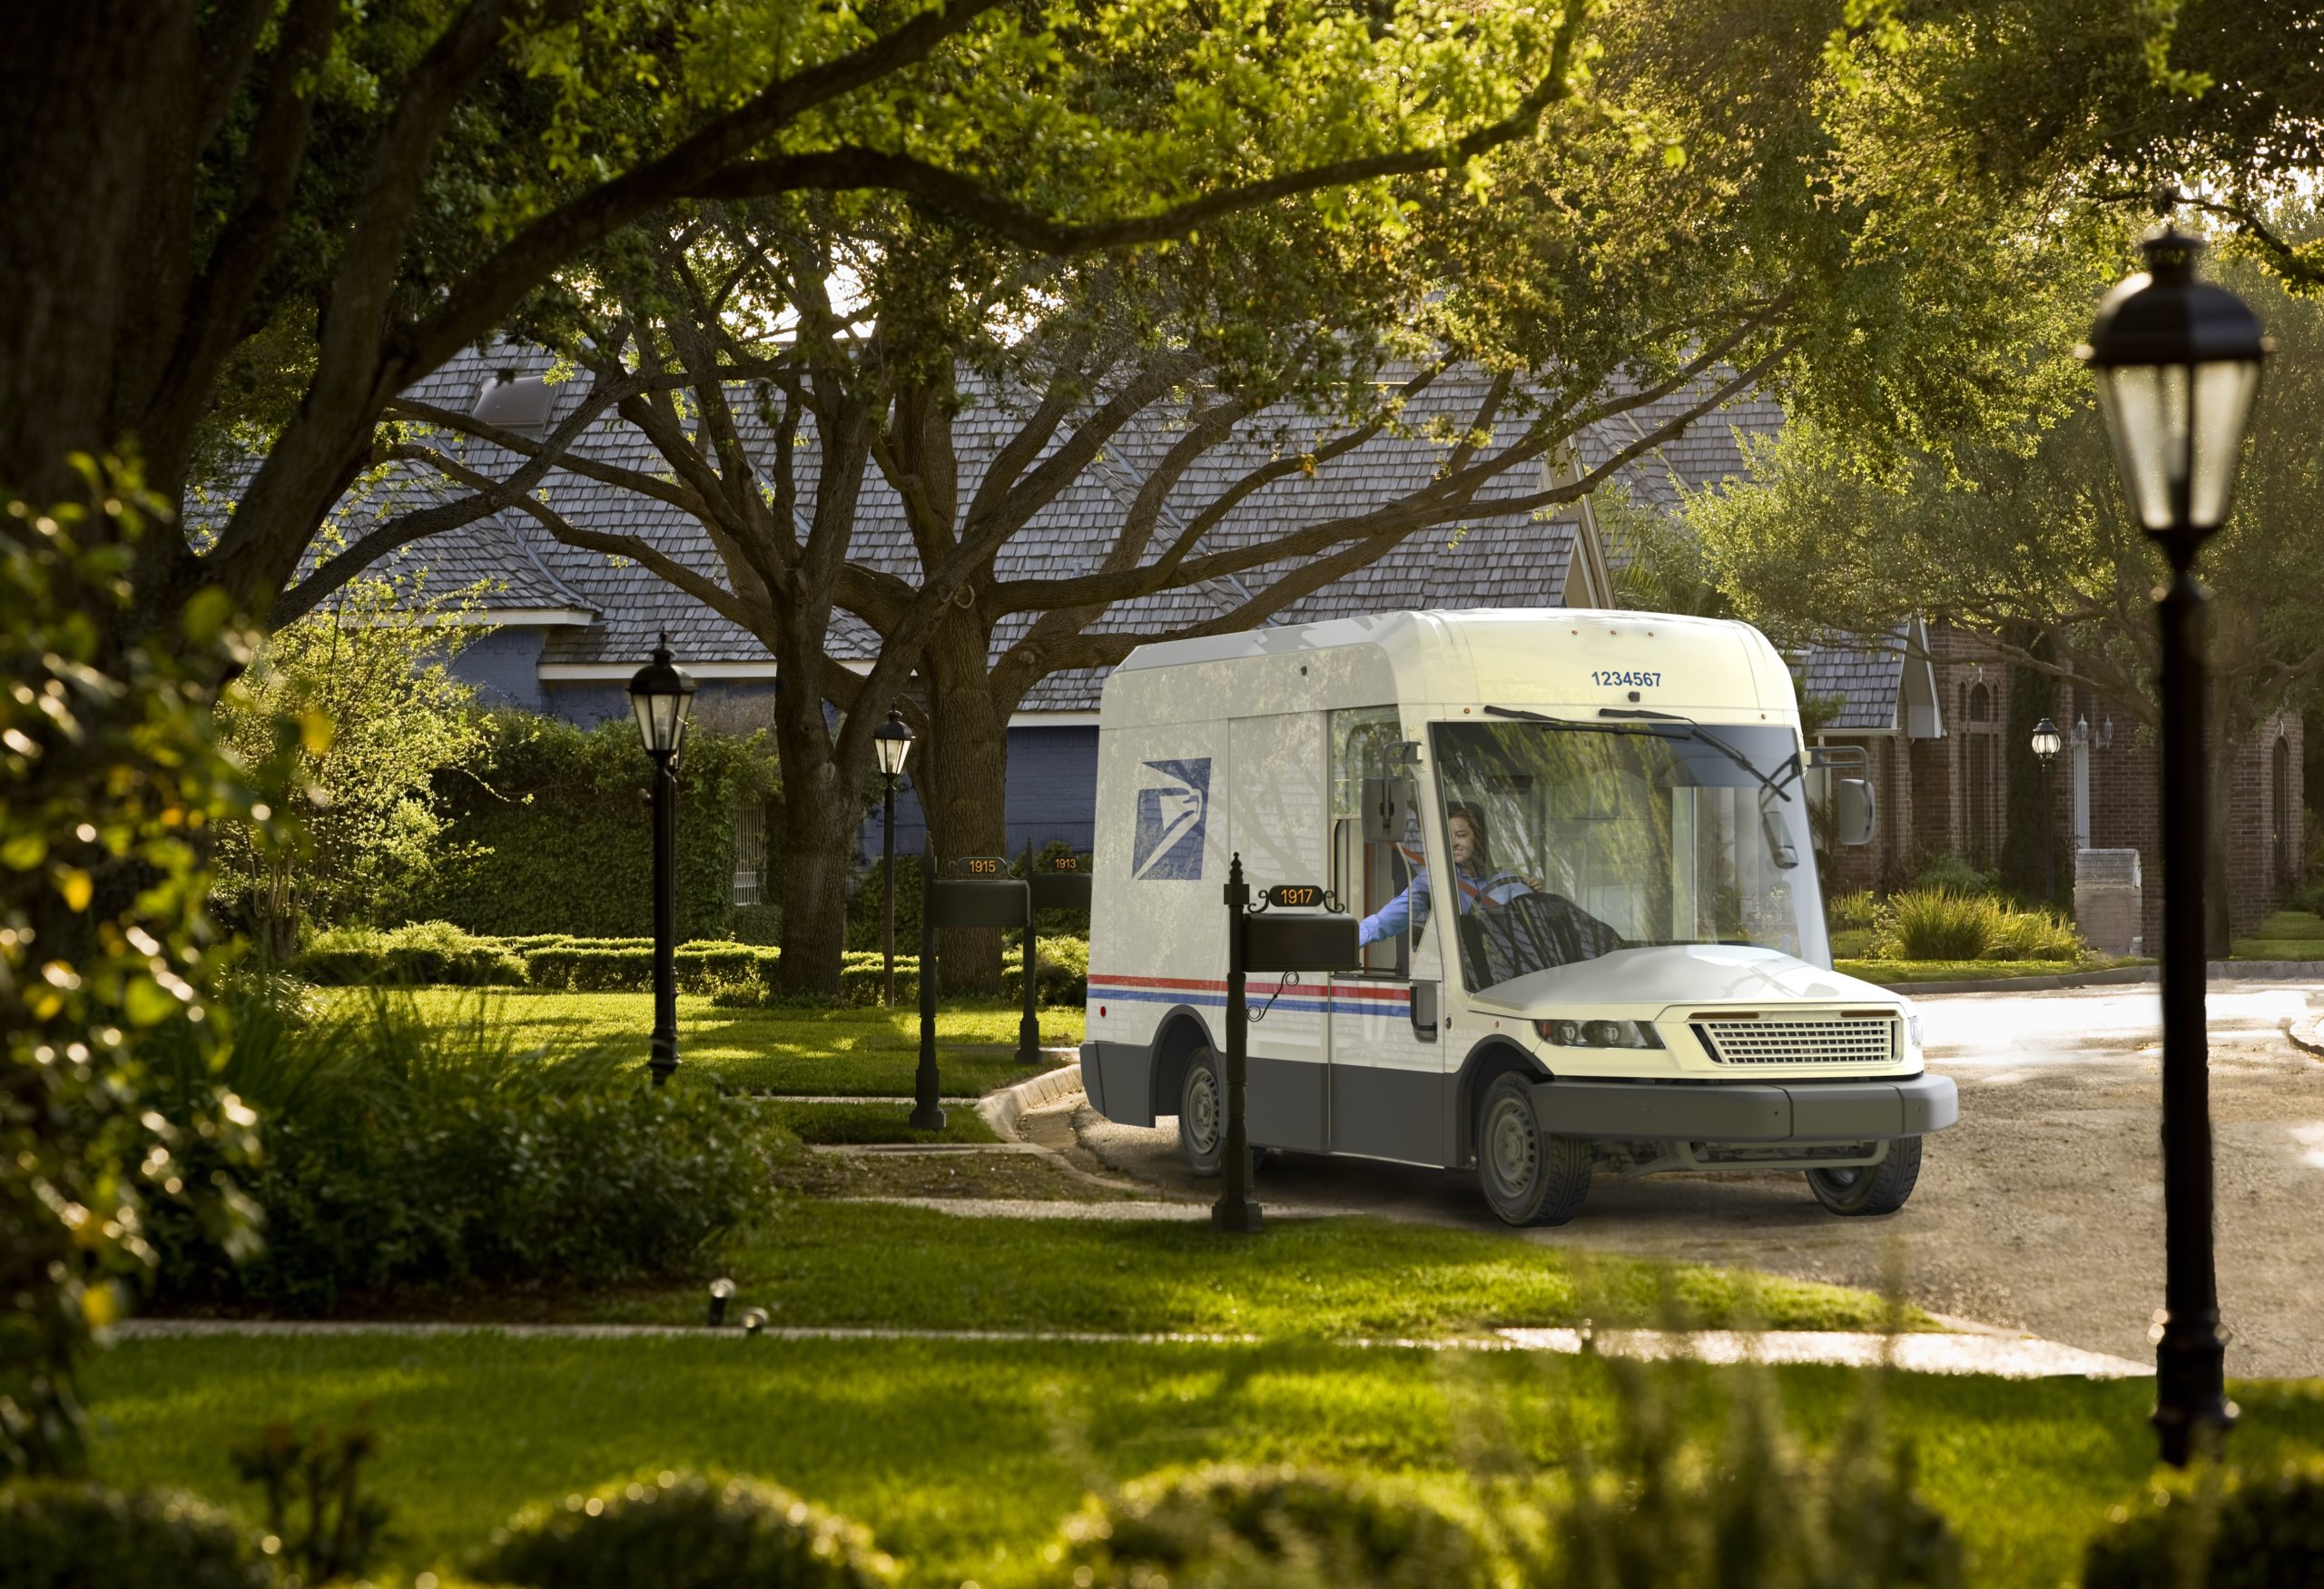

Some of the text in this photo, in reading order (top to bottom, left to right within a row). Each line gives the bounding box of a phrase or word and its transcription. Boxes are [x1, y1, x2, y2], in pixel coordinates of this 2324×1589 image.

[1591, 671, 1661, 687] 1234567
[969, 860, 996, 873] 1915
[1055, 858, 1077, 869] 1913
[1280, 888, 1314, 904] 1917
